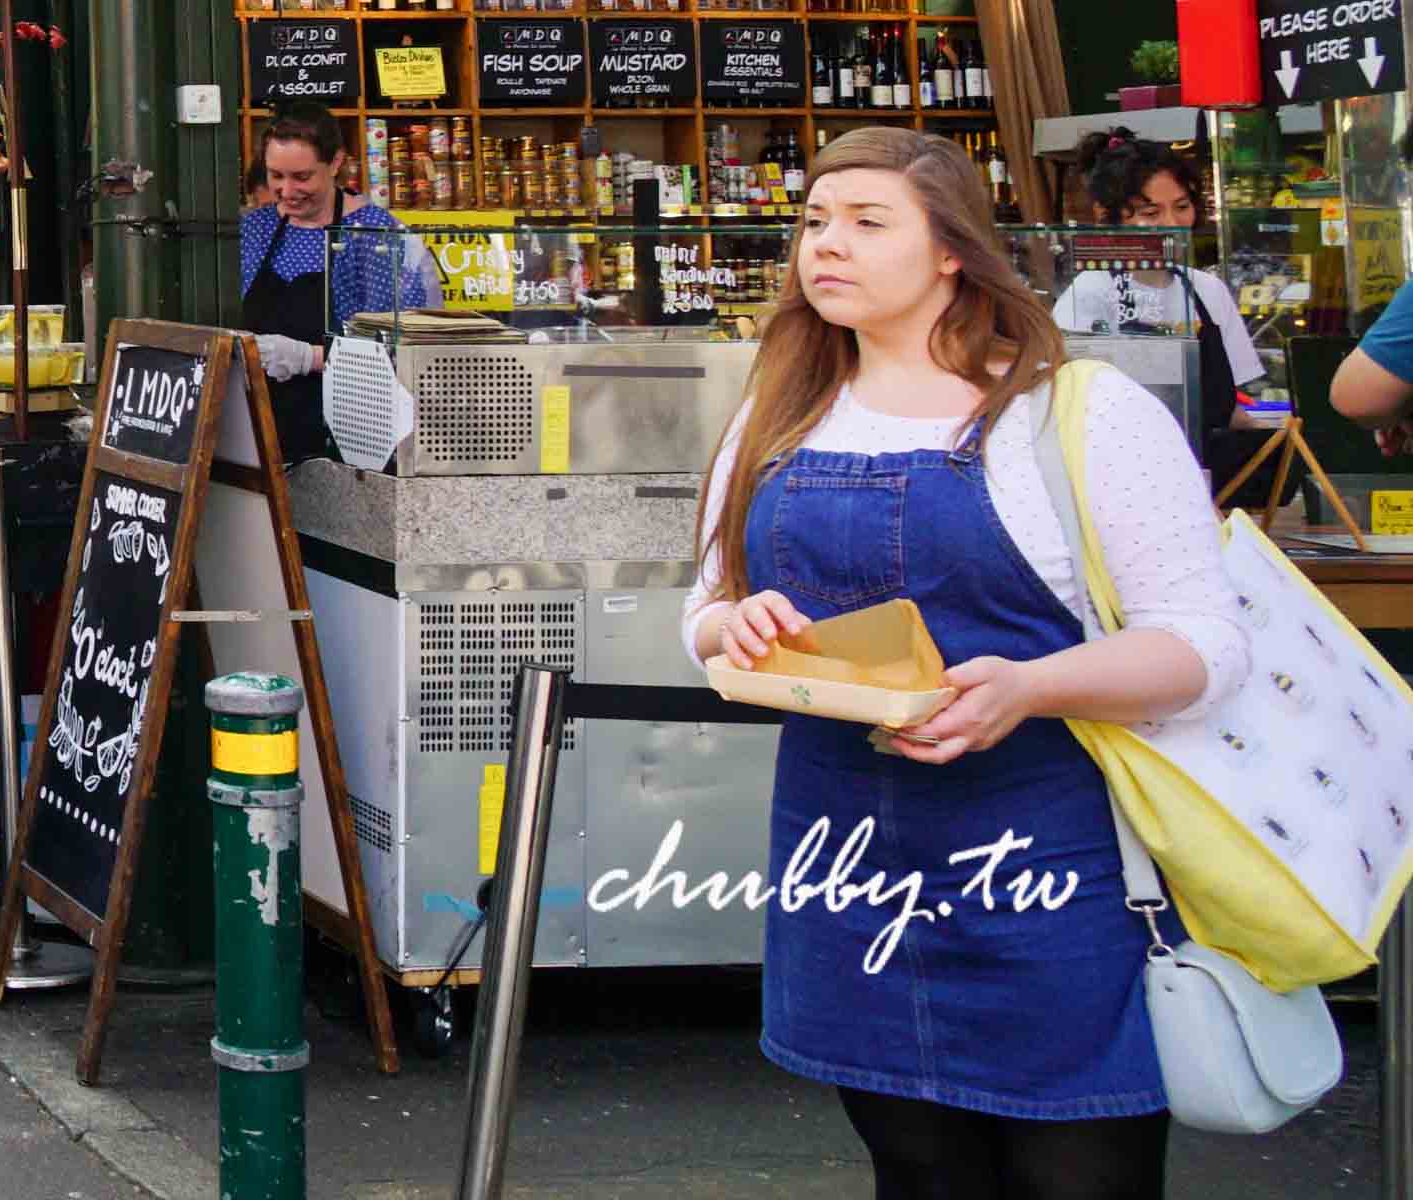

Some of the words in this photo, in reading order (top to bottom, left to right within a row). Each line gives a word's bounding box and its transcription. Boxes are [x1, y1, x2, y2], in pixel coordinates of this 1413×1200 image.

[1260, 7, 1328, 39] PLEASE
[301, 52, 348, 67] CONFIT
[726, 53, 781, 67] KITCHEN
[1306, 37, 1351, 65] HERE
[483, 53, 523, 72] FISH
[529, 53, 583, 72] SOUP
[599, 52, 687, 72] MUSTARD
[297, 69, 309, 81] &
[627, 75, 655, 84] DIJON
[724, 66, 784, 78] ESSENTIALS
[609, 85, 642, 95] WHOLE
[644, 84, 671, 94] GRAIN
[654, 243, 699, 264] mini
[659, 266, 736, 287] sandwich
[123, 367, 187, 428] LMDQ
